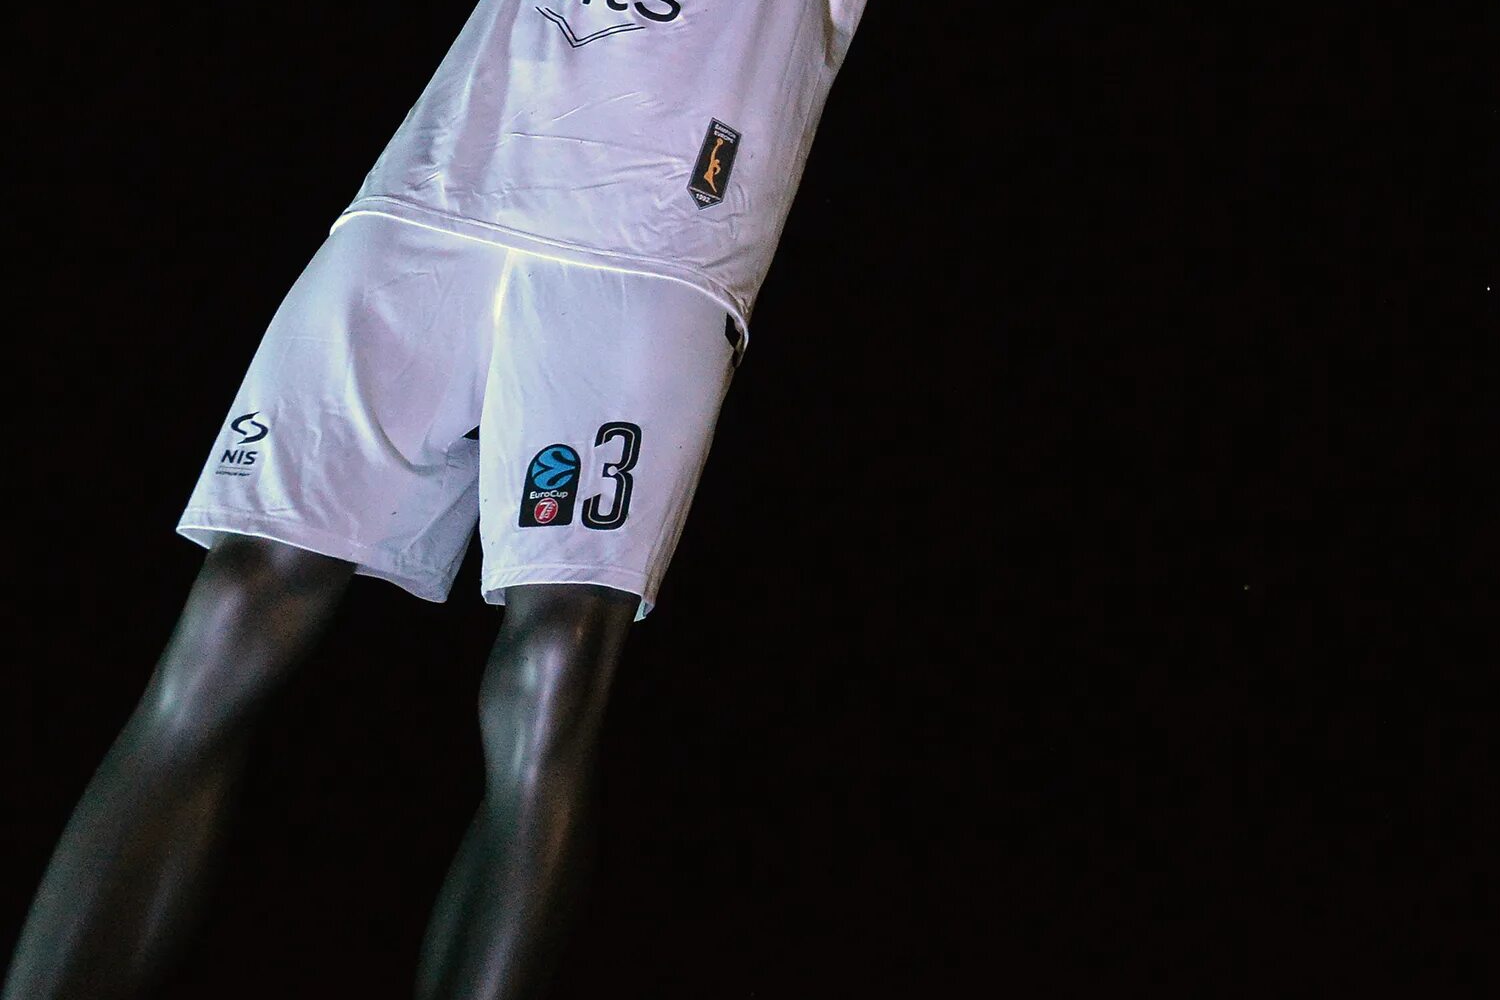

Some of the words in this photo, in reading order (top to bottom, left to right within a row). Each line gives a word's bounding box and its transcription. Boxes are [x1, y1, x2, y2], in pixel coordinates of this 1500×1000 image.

[221, 449, 258, 465] NIS
[581, 421, 642, 530] 3
[529, 489, 569, 499] EuroCup
